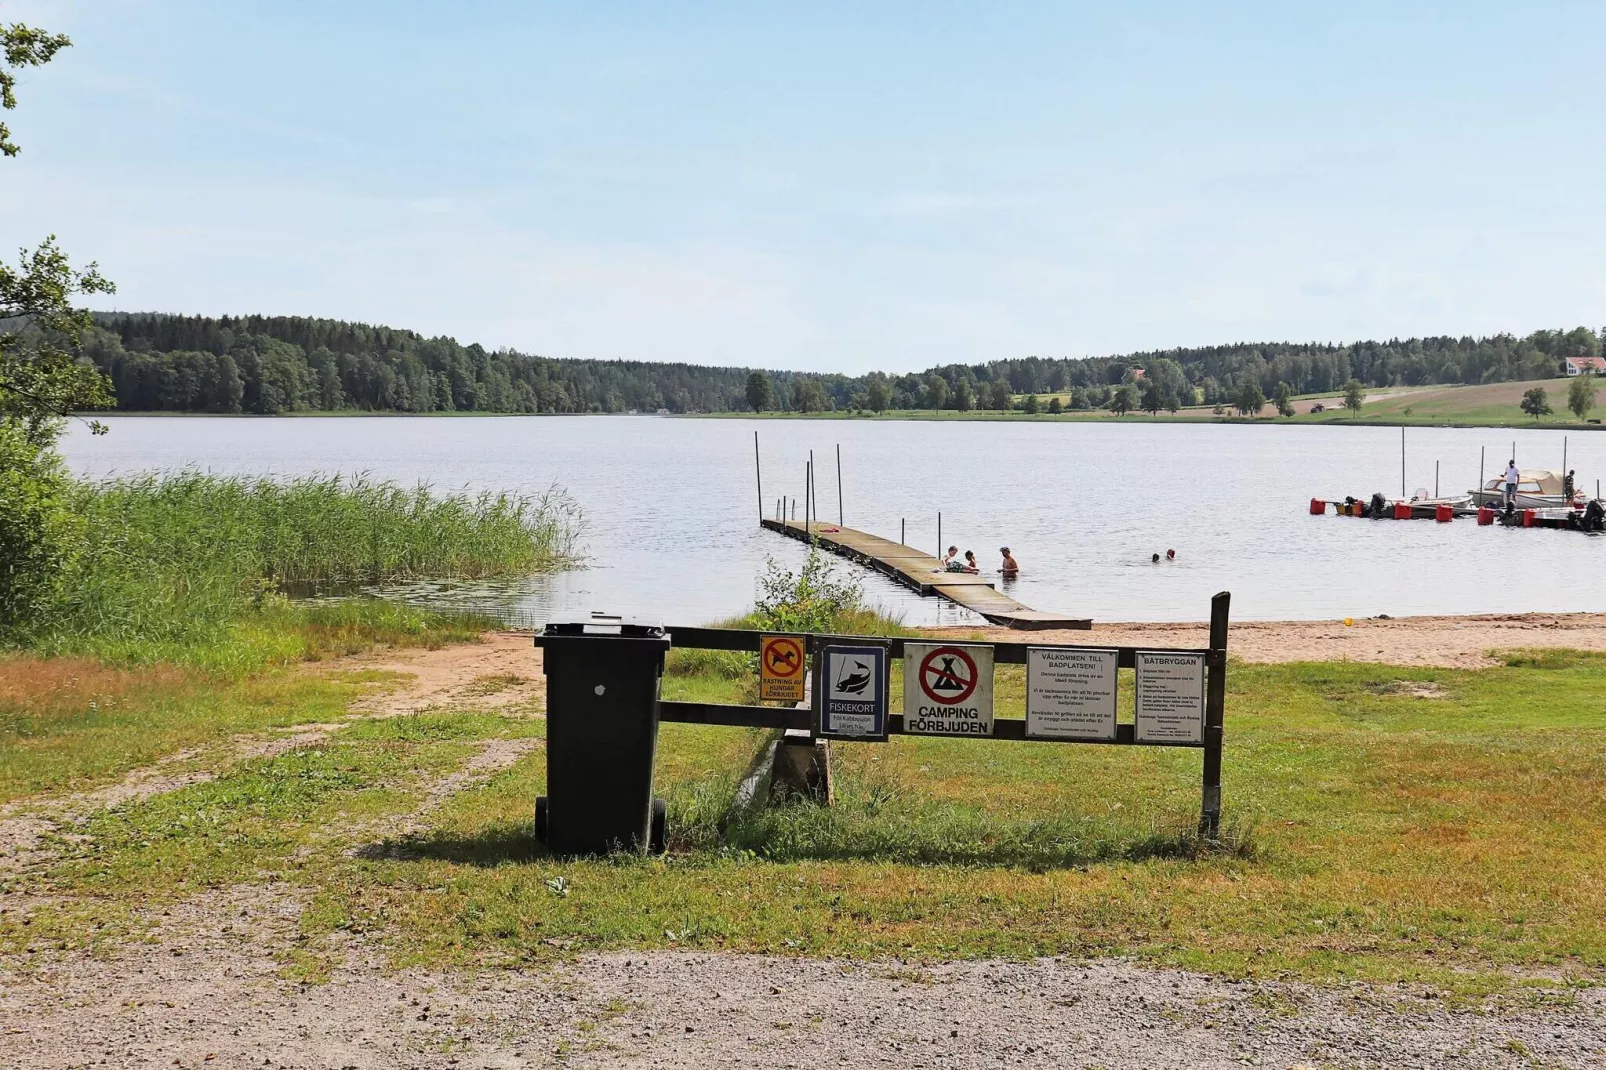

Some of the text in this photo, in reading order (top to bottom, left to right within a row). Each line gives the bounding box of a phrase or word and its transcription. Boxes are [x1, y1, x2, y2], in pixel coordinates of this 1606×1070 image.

[830, 702, 875, 712] FISKEKORT
[919, 706, 978, 719] CAMPING
[909, 718, 988, 733] FÖRBJUDEN
